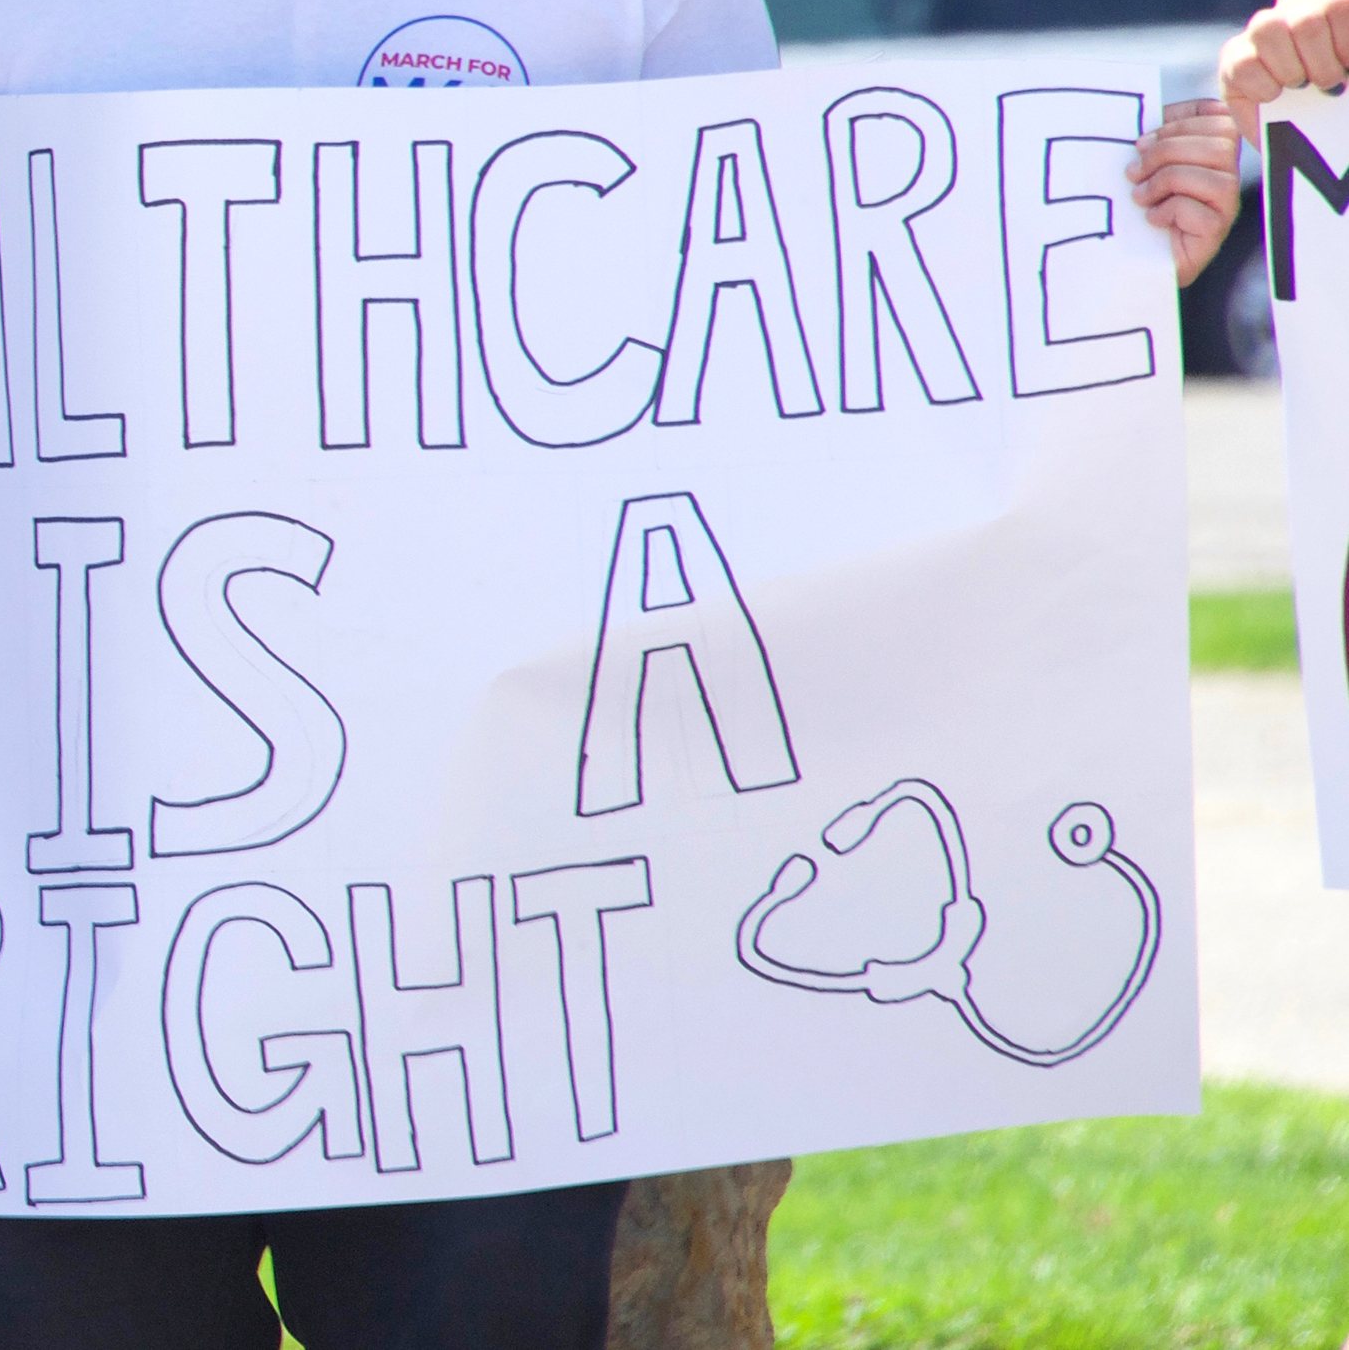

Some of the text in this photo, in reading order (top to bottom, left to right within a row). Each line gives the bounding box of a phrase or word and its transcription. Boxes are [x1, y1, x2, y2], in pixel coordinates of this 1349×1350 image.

[380, 52, 511, 81] MARCH FOR
[26, 492, 802, 874] IS A
